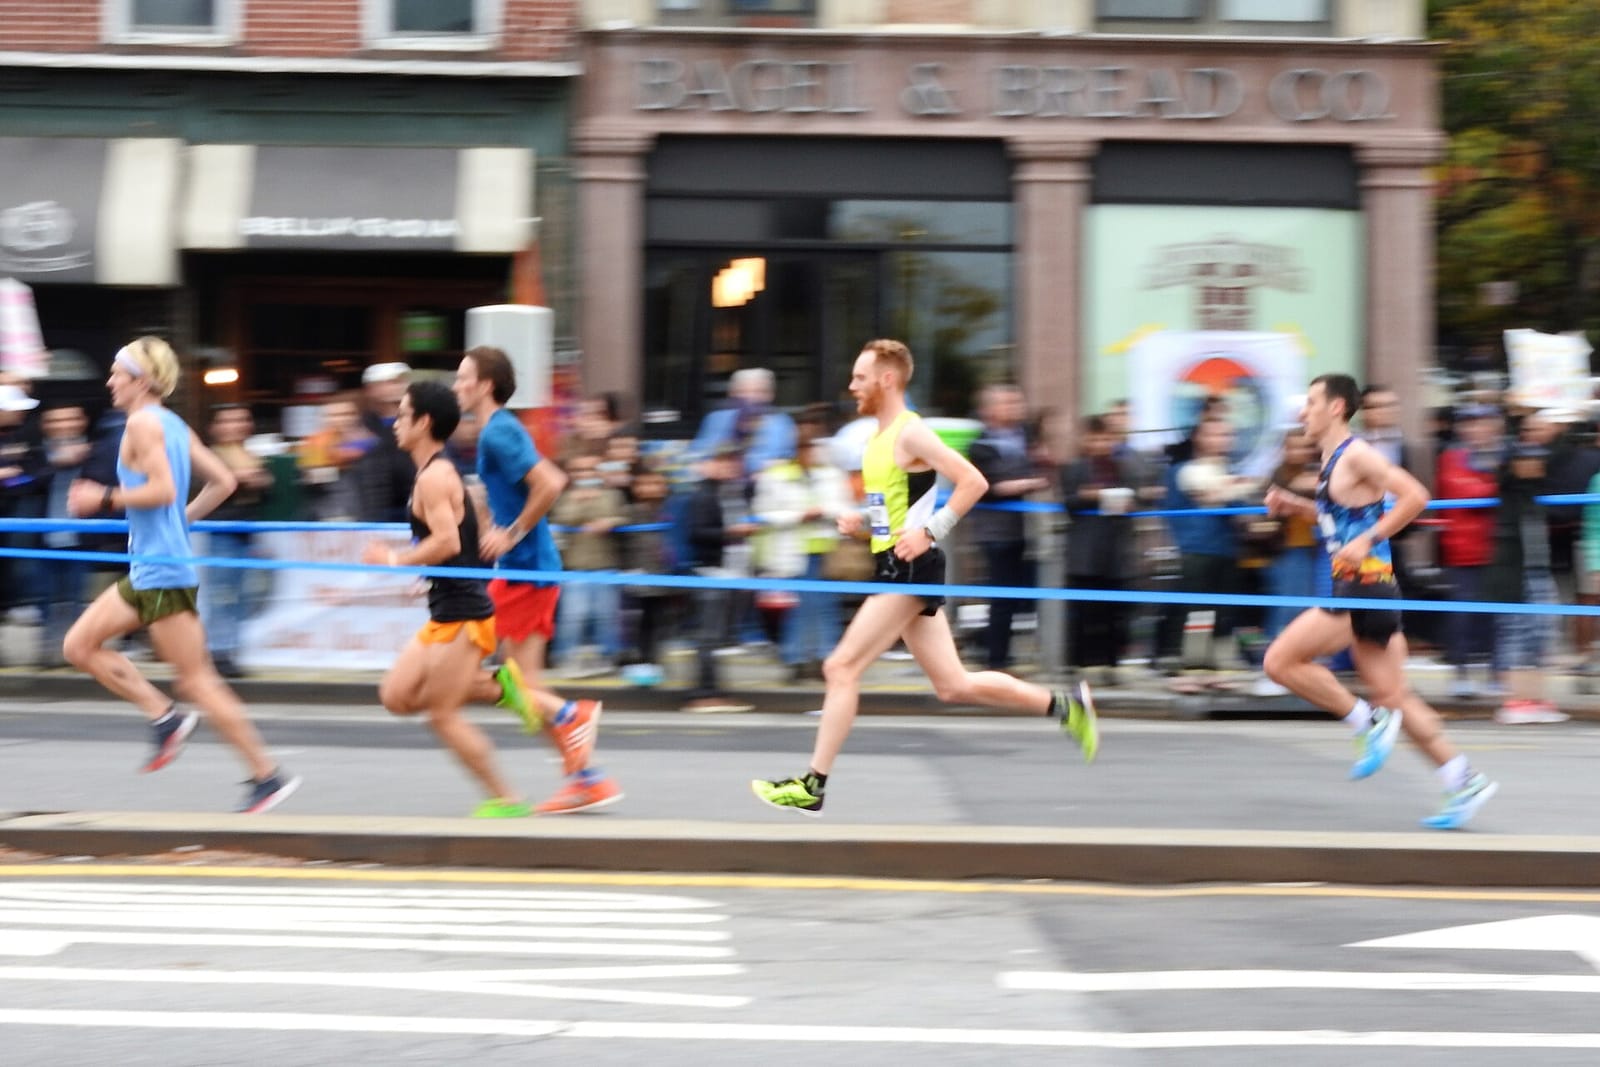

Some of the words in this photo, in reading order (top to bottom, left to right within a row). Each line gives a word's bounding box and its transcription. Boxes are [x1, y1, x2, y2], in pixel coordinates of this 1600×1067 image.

[634, 57, 868, 113] BAGEL
[902, 62, 962, 115] &
[992, 65, 1243, 120] BREAD
